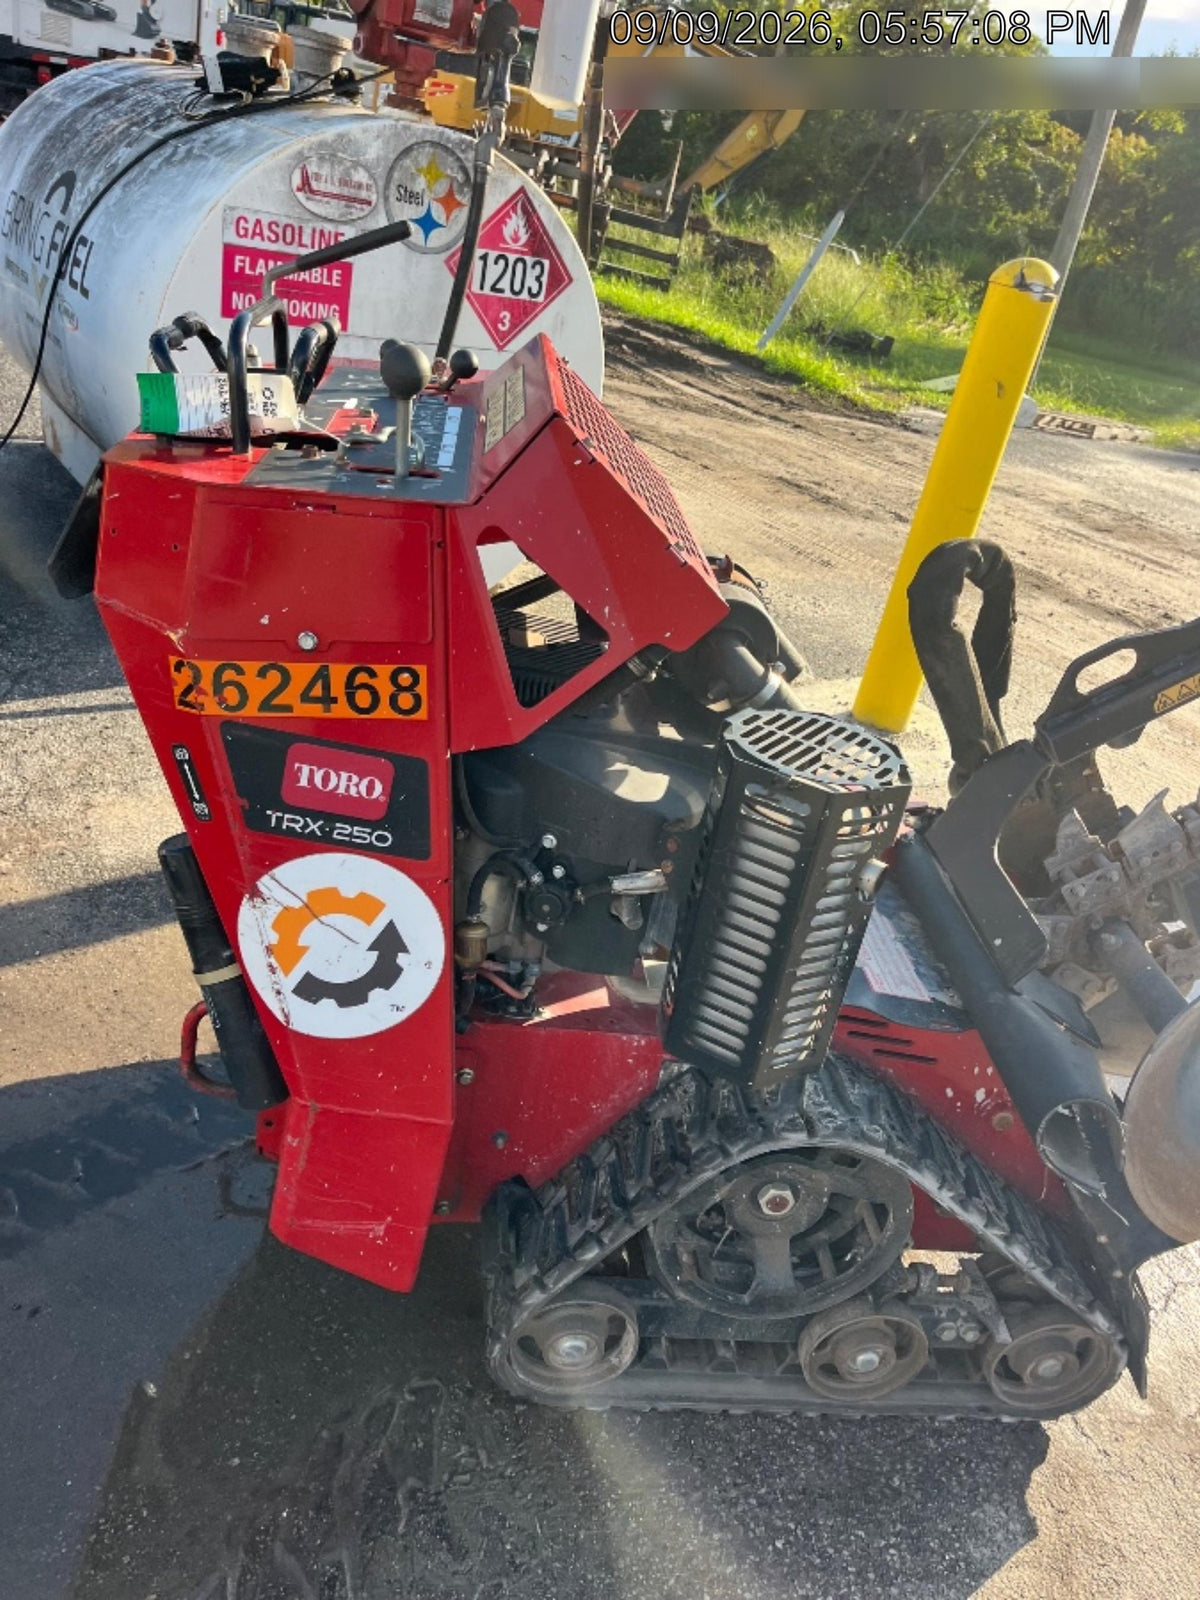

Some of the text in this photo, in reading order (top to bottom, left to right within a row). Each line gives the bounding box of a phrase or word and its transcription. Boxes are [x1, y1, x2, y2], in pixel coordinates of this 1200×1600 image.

[396, 184, 425, 207] Steel
[45, 220, 95, 300] FUEL
[478, 251, 546, 299] 1203
[231, 291, 340, 320] NO OKING
[497, 310, 511, 331] 3
[173, 659, 423, 716] 262468
[294, 762, 383, 800] TORO
